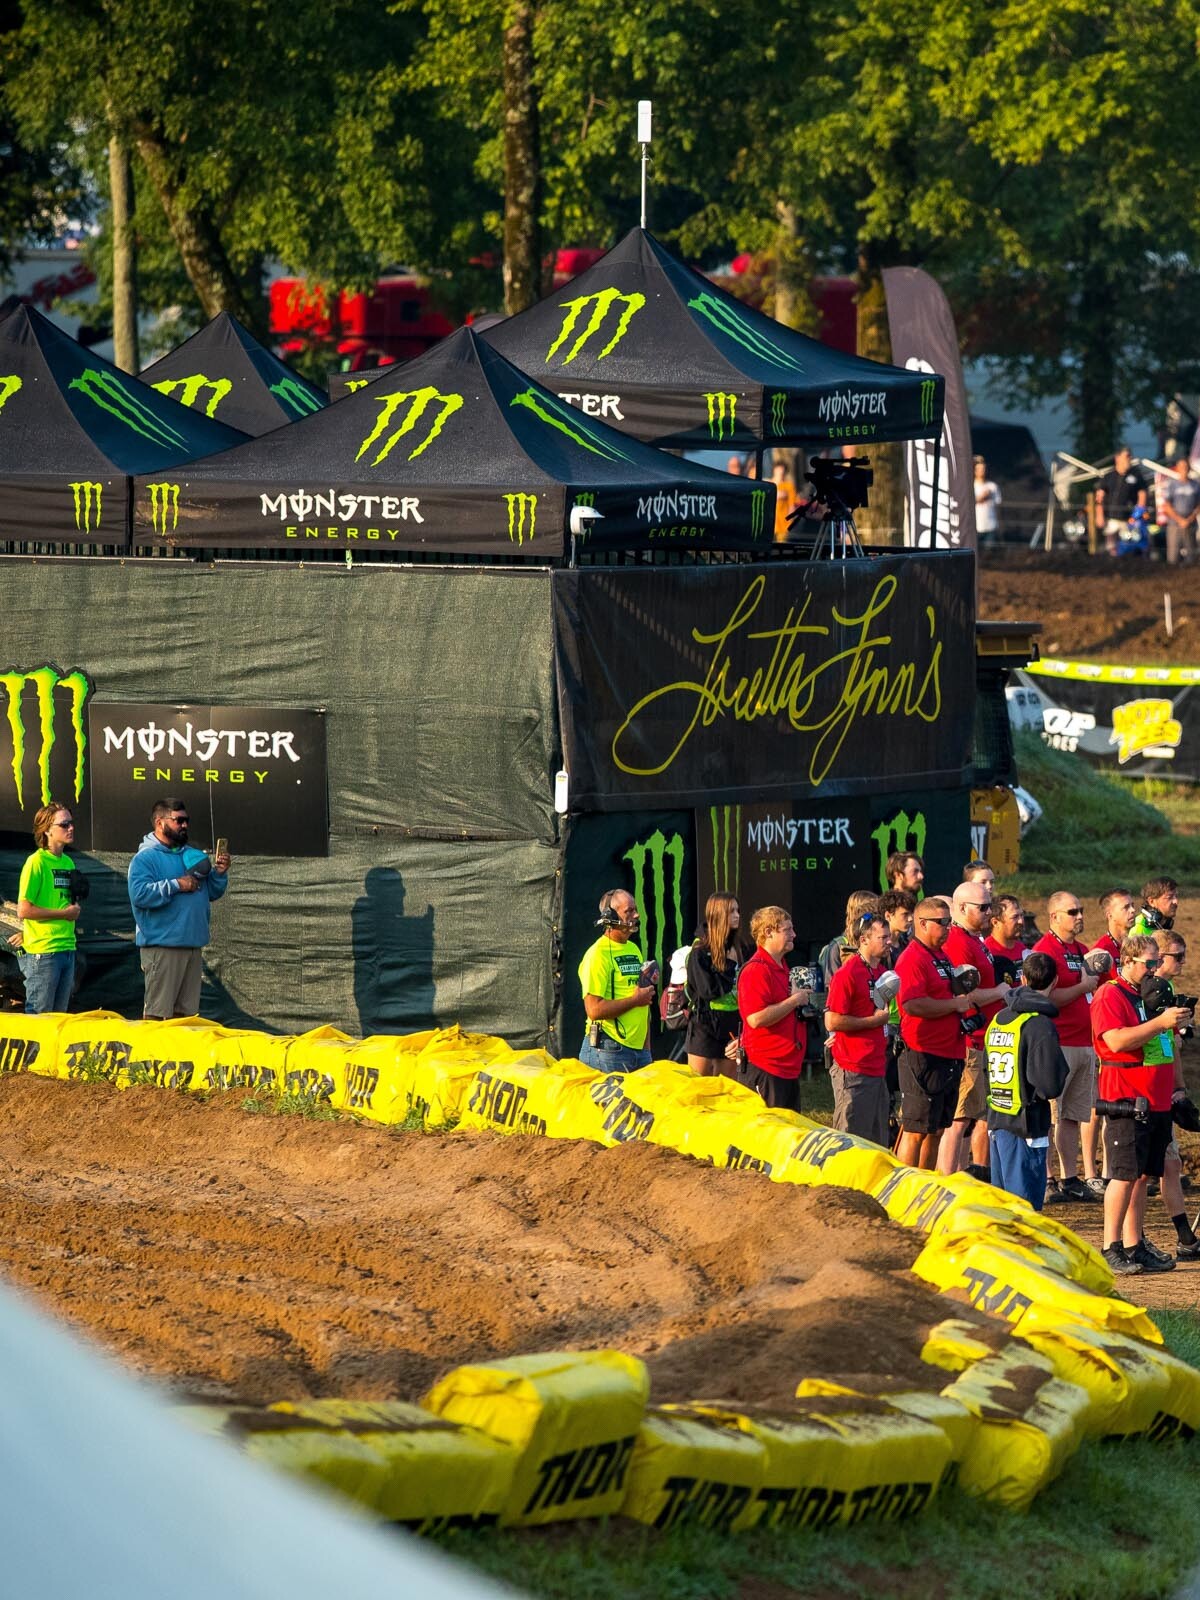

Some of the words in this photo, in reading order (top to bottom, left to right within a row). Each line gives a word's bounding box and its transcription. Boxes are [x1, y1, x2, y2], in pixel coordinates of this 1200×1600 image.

[818, 390, 887, 422] MONSTER
[828, 424, 877, 438] ENERGY
[260, 488, 424, 524] MONSTER
[636, 490, 718, 522] MONSTER
[950, 495, 961, 545] KET
[286, 526, 400, 541] ENERGY
[648, 526, 707, 539] ENERGY
[103, 721, 301, 763] MONSTER
[132, 767, 269, 784] ENERGY
[747, 813, 856, 852] MONSTER
[760, 857, 834, 872] ENERGY
[469, 1071, 528, 1128] THOR
[524, 1435, 638, 1515] THOR
